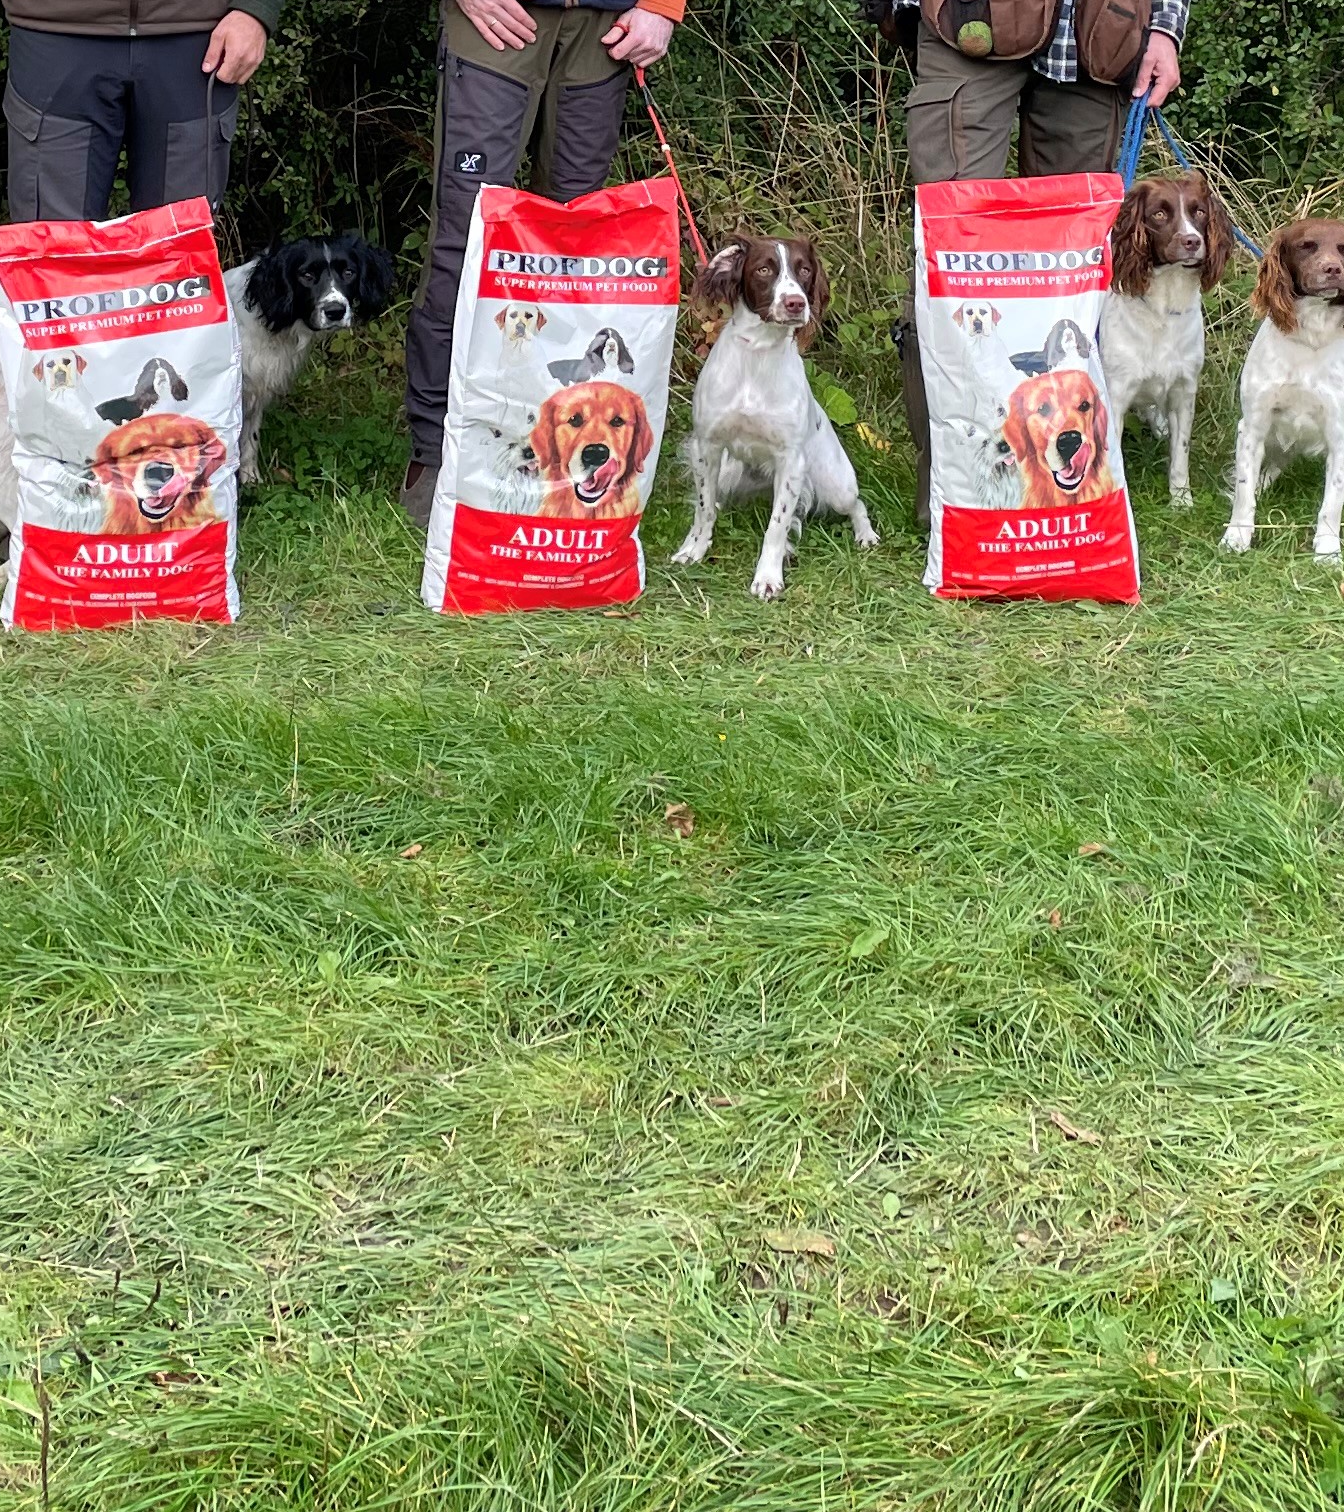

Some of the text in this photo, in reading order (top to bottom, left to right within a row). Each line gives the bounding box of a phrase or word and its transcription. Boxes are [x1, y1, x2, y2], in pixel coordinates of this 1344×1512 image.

[496, 251, 661, 278] PROFDOG
[943, 246, 1104, 271] PROFDOG
[494, 275, 658, 293] SUPER PREMIUM PET FOOD
[947, 269, 1104, 287] SUPER PREMIUM PET FOOD
[22, 277, 203, 322] PROFDOG
[25, 303, 204, 338] SUPER PREMIUM PET FOOD
[996, 512, 1091, 539] ADULT
[508, 526, 609, 550] ADULT
[978, 531, 1106, 553] THE FAMILY DOG
[72, 542, 179, 565] ADULT
[490, 544, 523, 559] THE
[526, 551, 584, 564] FAMILY
[54, 563, 194, 579] THE FAMILY DOG
